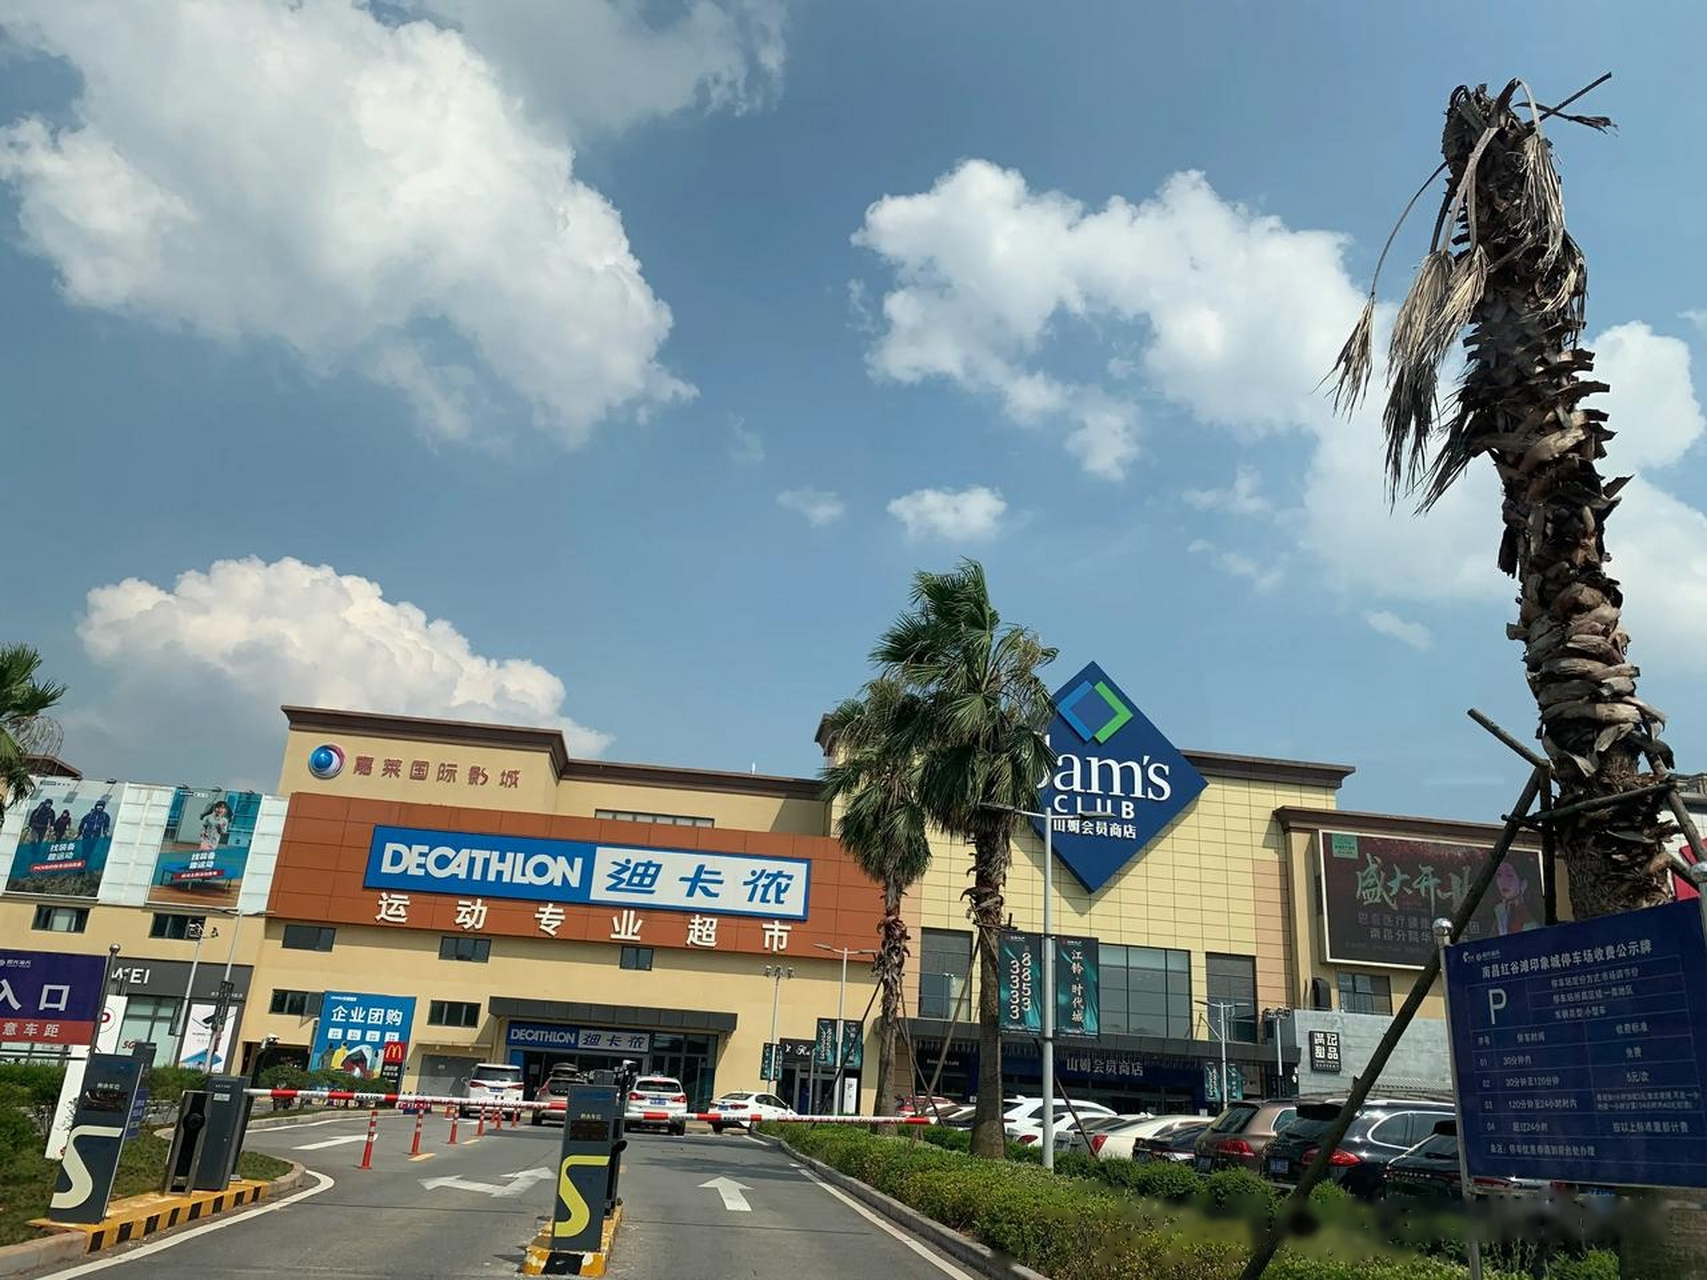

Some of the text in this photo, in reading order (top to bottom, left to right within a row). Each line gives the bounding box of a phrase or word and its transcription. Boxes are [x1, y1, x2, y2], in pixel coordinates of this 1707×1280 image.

[353, 755, 520, 788] 嘉莱国际影城
[1053, 819, 1137, 838] 山姆会员商店
[381, 842, 794, 904] DECATHLON 迪卡侬
[375, 892, 793, 952] 运动专业超市
[1009, 959, 1020, 1020] 3333
[1021, 952, 1032, 1012] 8853
[331, 1005, 403, 1026] 企业团购
[1488, 988, 1507, 1025] P
[510, 1028, 575, 1044] DECATHLON
[1066, 1057, 1144, 1077] 山姆会员商店
